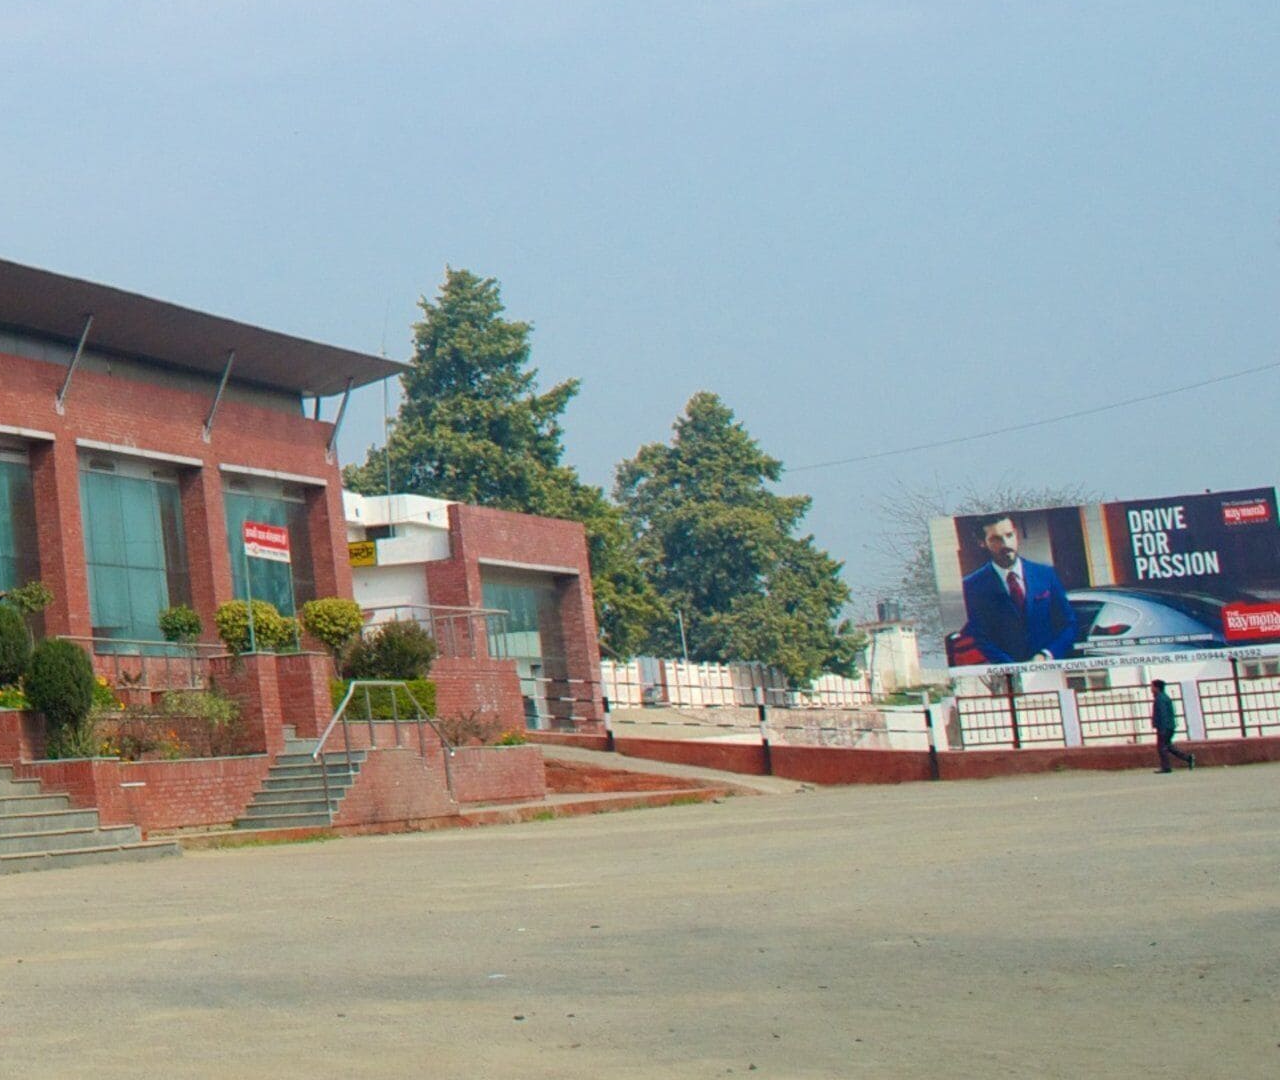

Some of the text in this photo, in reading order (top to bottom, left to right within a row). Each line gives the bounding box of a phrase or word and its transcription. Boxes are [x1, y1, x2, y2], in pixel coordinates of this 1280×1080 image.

[1128, 506, 1187, 533] DRIVE
[1132, 531, 1170, 557] FOR
[1136, 551, 1219, 580] PASSION
